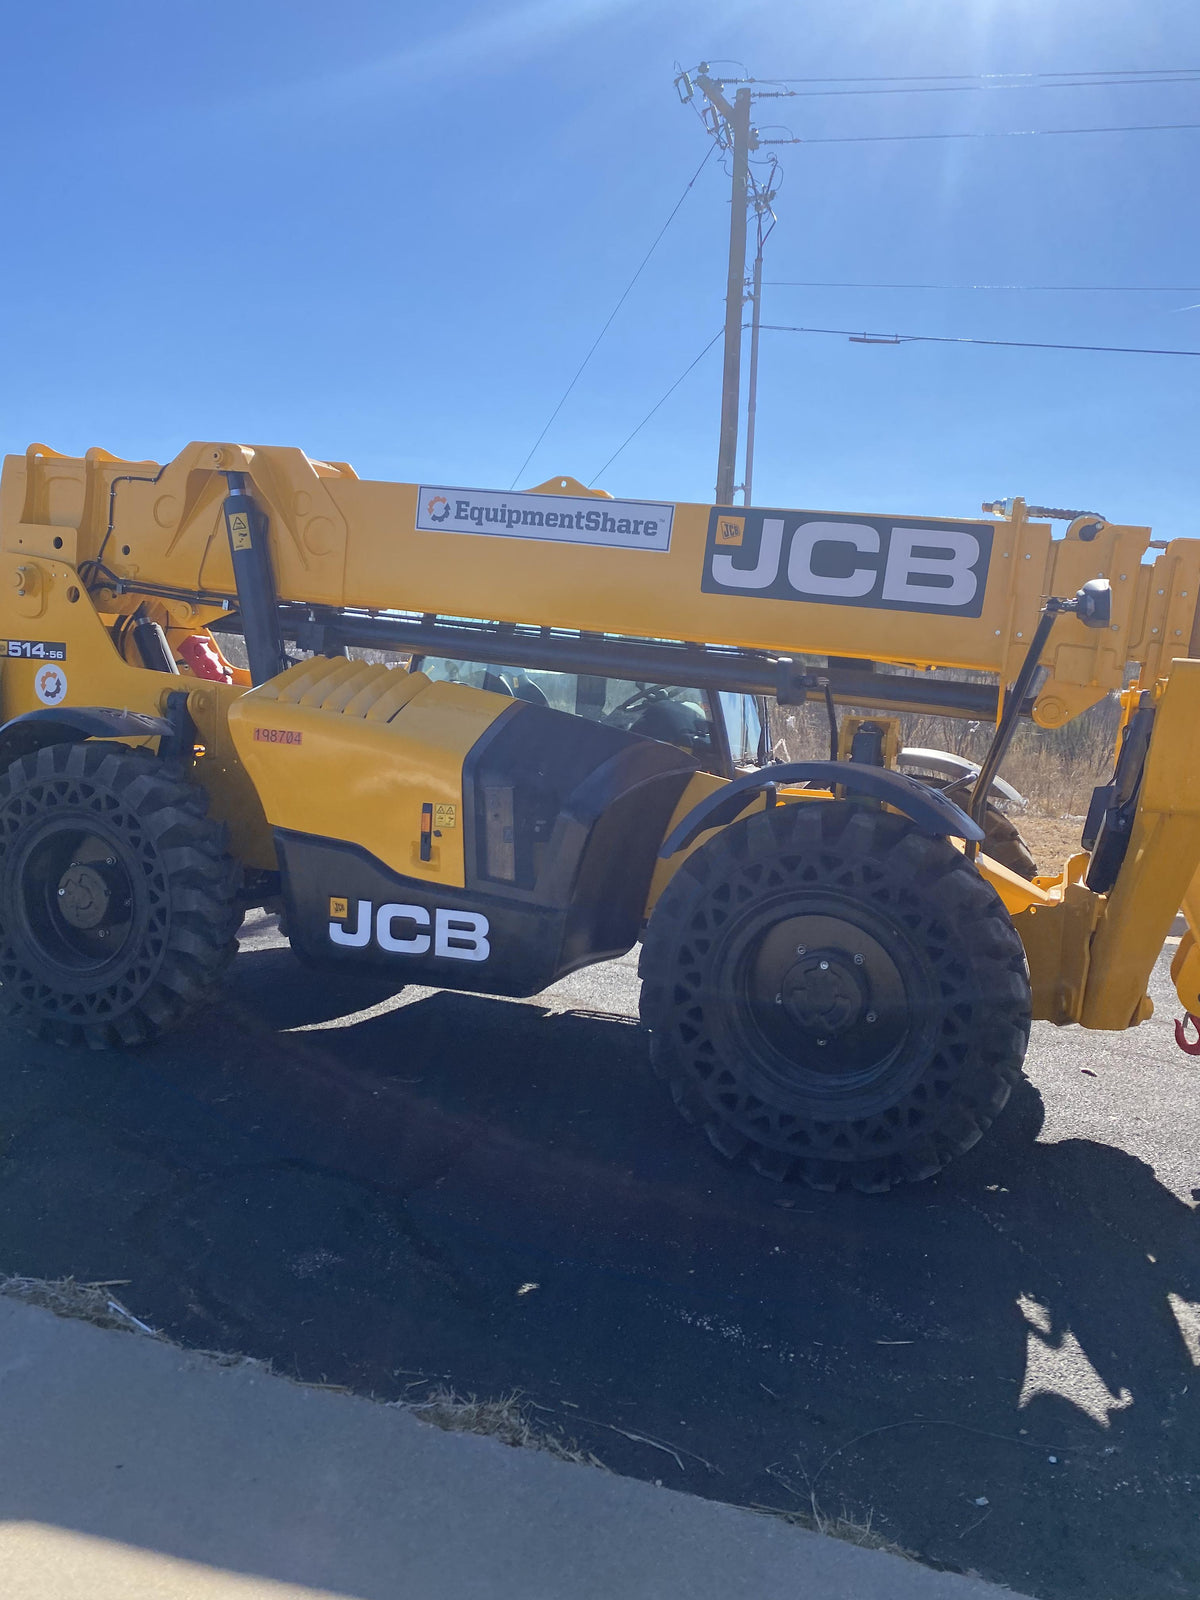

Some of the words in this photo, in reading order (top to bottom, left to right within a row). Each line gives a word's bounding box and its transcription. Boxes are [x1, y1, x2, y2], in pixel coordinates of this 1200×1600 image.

[454, 500, 658, 536] EquipmentShare
[711, 518, 980, 606] JCB
[255, 728, 302, 745] 198704
[329, 900, 491, 962] JCB
